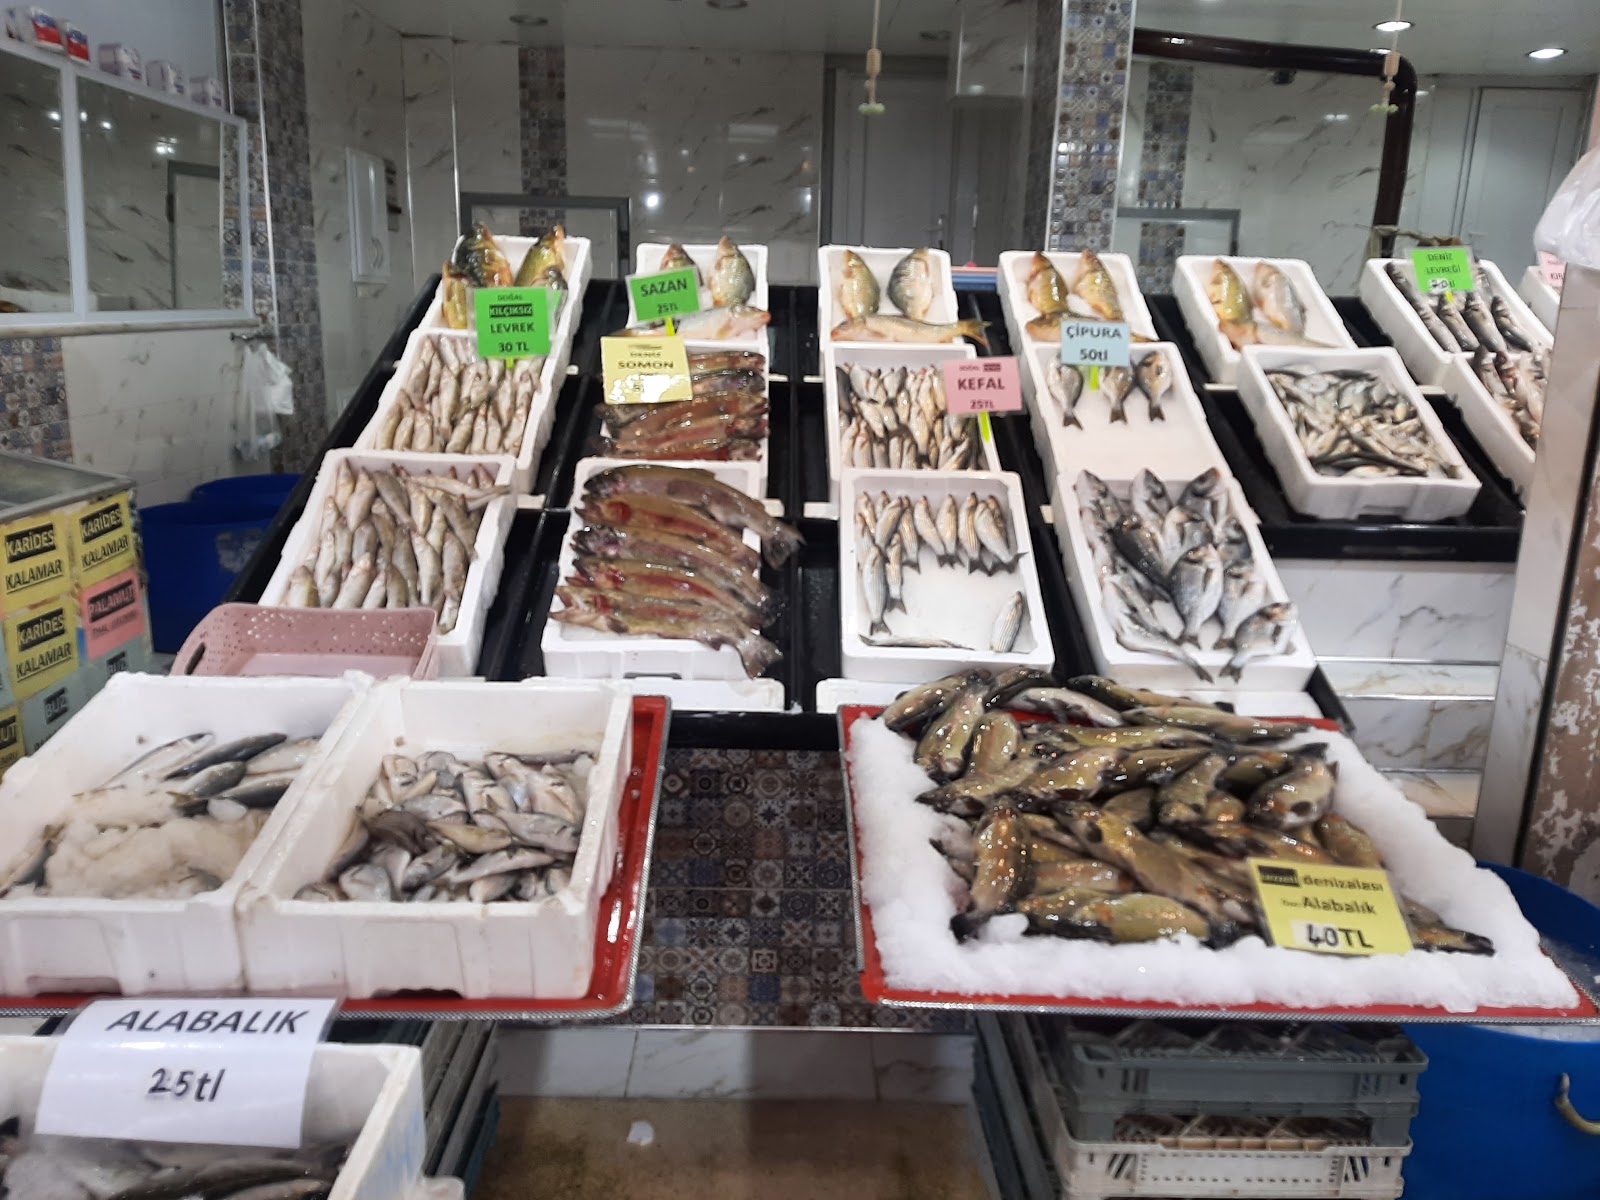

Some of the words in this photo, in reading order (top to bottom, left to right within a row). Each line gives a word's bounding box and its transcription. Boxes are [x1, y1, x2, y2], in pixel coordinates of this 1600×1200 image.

[640, 277, 688, 297] SAZAN
[657, 302, 678, 315] 25TL
[490, 322, 535, 334] LEVREK
[1066, 325, 1122, 340] ÇİPURA
[498, 341, 512, 353] 30
[516, 341, 530, 352] TL
[1079, 348, 1107, 362] 50tl
[618, 360, 674, 369] SOMON
[957, 377, 1006, 391] KEFAL
[81, 508, 122, 537] KARİDES
[6, 528, 55, 557] KARİDES
[82, 533, 129, 568] KALAMAR
[6, 558, 63, 590] KALAMAR
[88, 586, 134, 616] PALAMUT
[18, 613, 65, 645] KARİDES
[16, 641, 72, 679] KALAMAR
[45, 694, 68, 717] BUZ
[1303, 896, 1377, 915] Alabalık
[1307, 924, 1374, 948] 40TL
[105, 1009, 309, 1034] ALABALIK
[147, 1067, 225, 1102] 25tl
